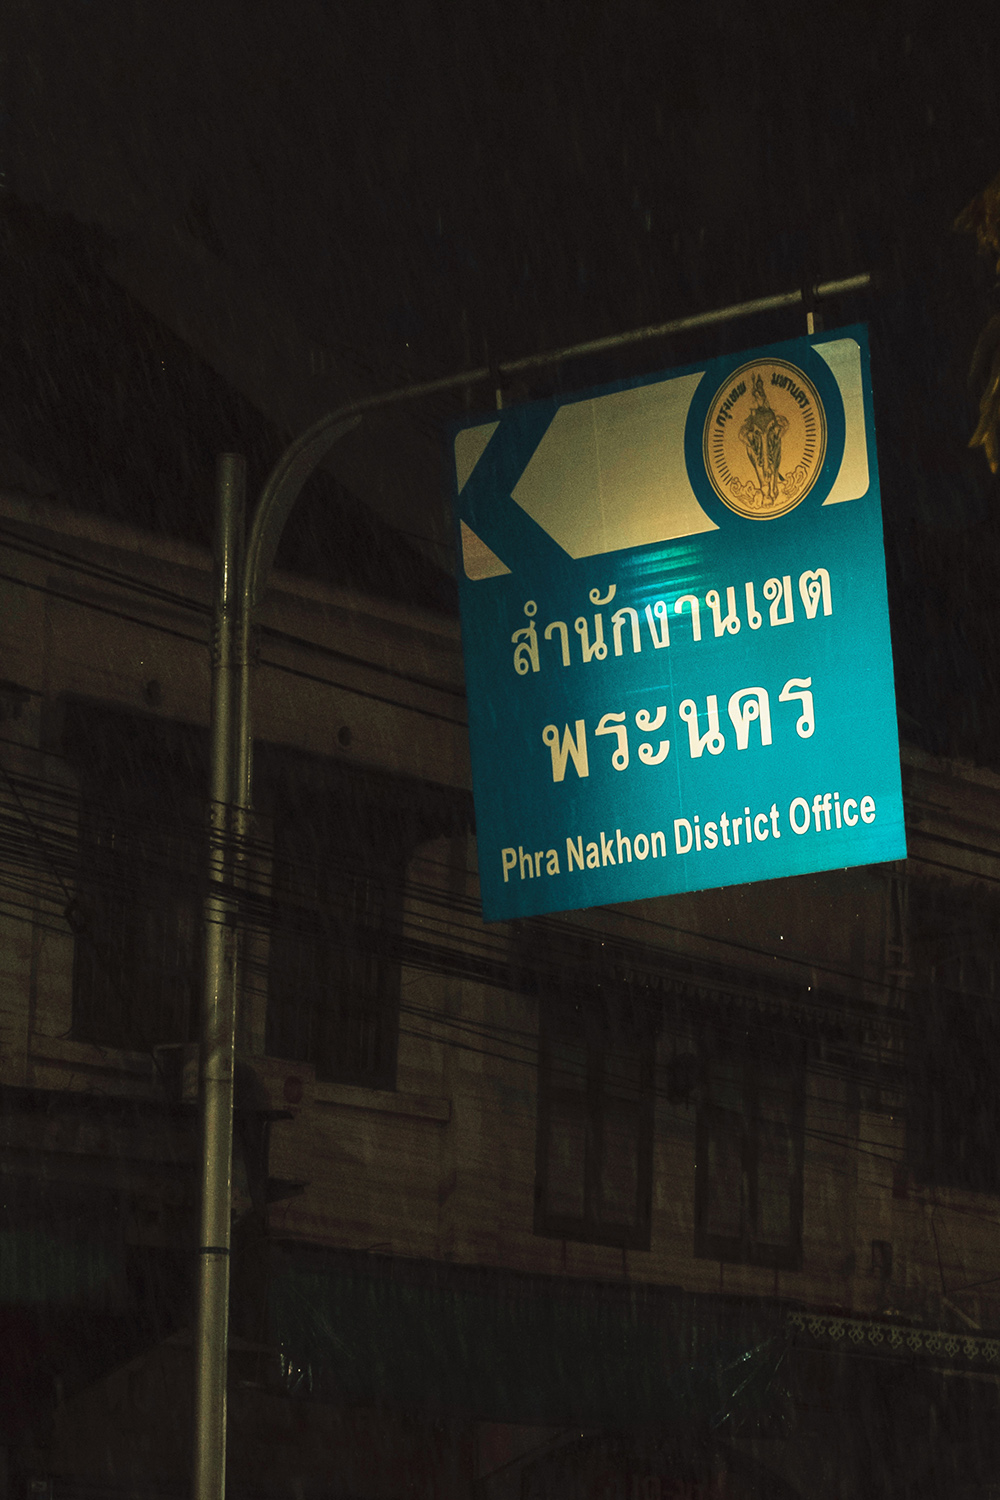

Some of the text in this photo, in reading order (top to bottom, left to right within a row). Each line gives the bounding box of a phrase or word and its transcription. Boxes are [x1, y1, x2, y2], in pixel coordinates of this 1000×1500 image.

[770, 371, 810, 409] มหานคร
[511, 566, 834, 676] สำนักงานเขต
[541, 676, 817, 783] พระนคร
[501, 790, 877, 883] Phra Nakhon District Office
